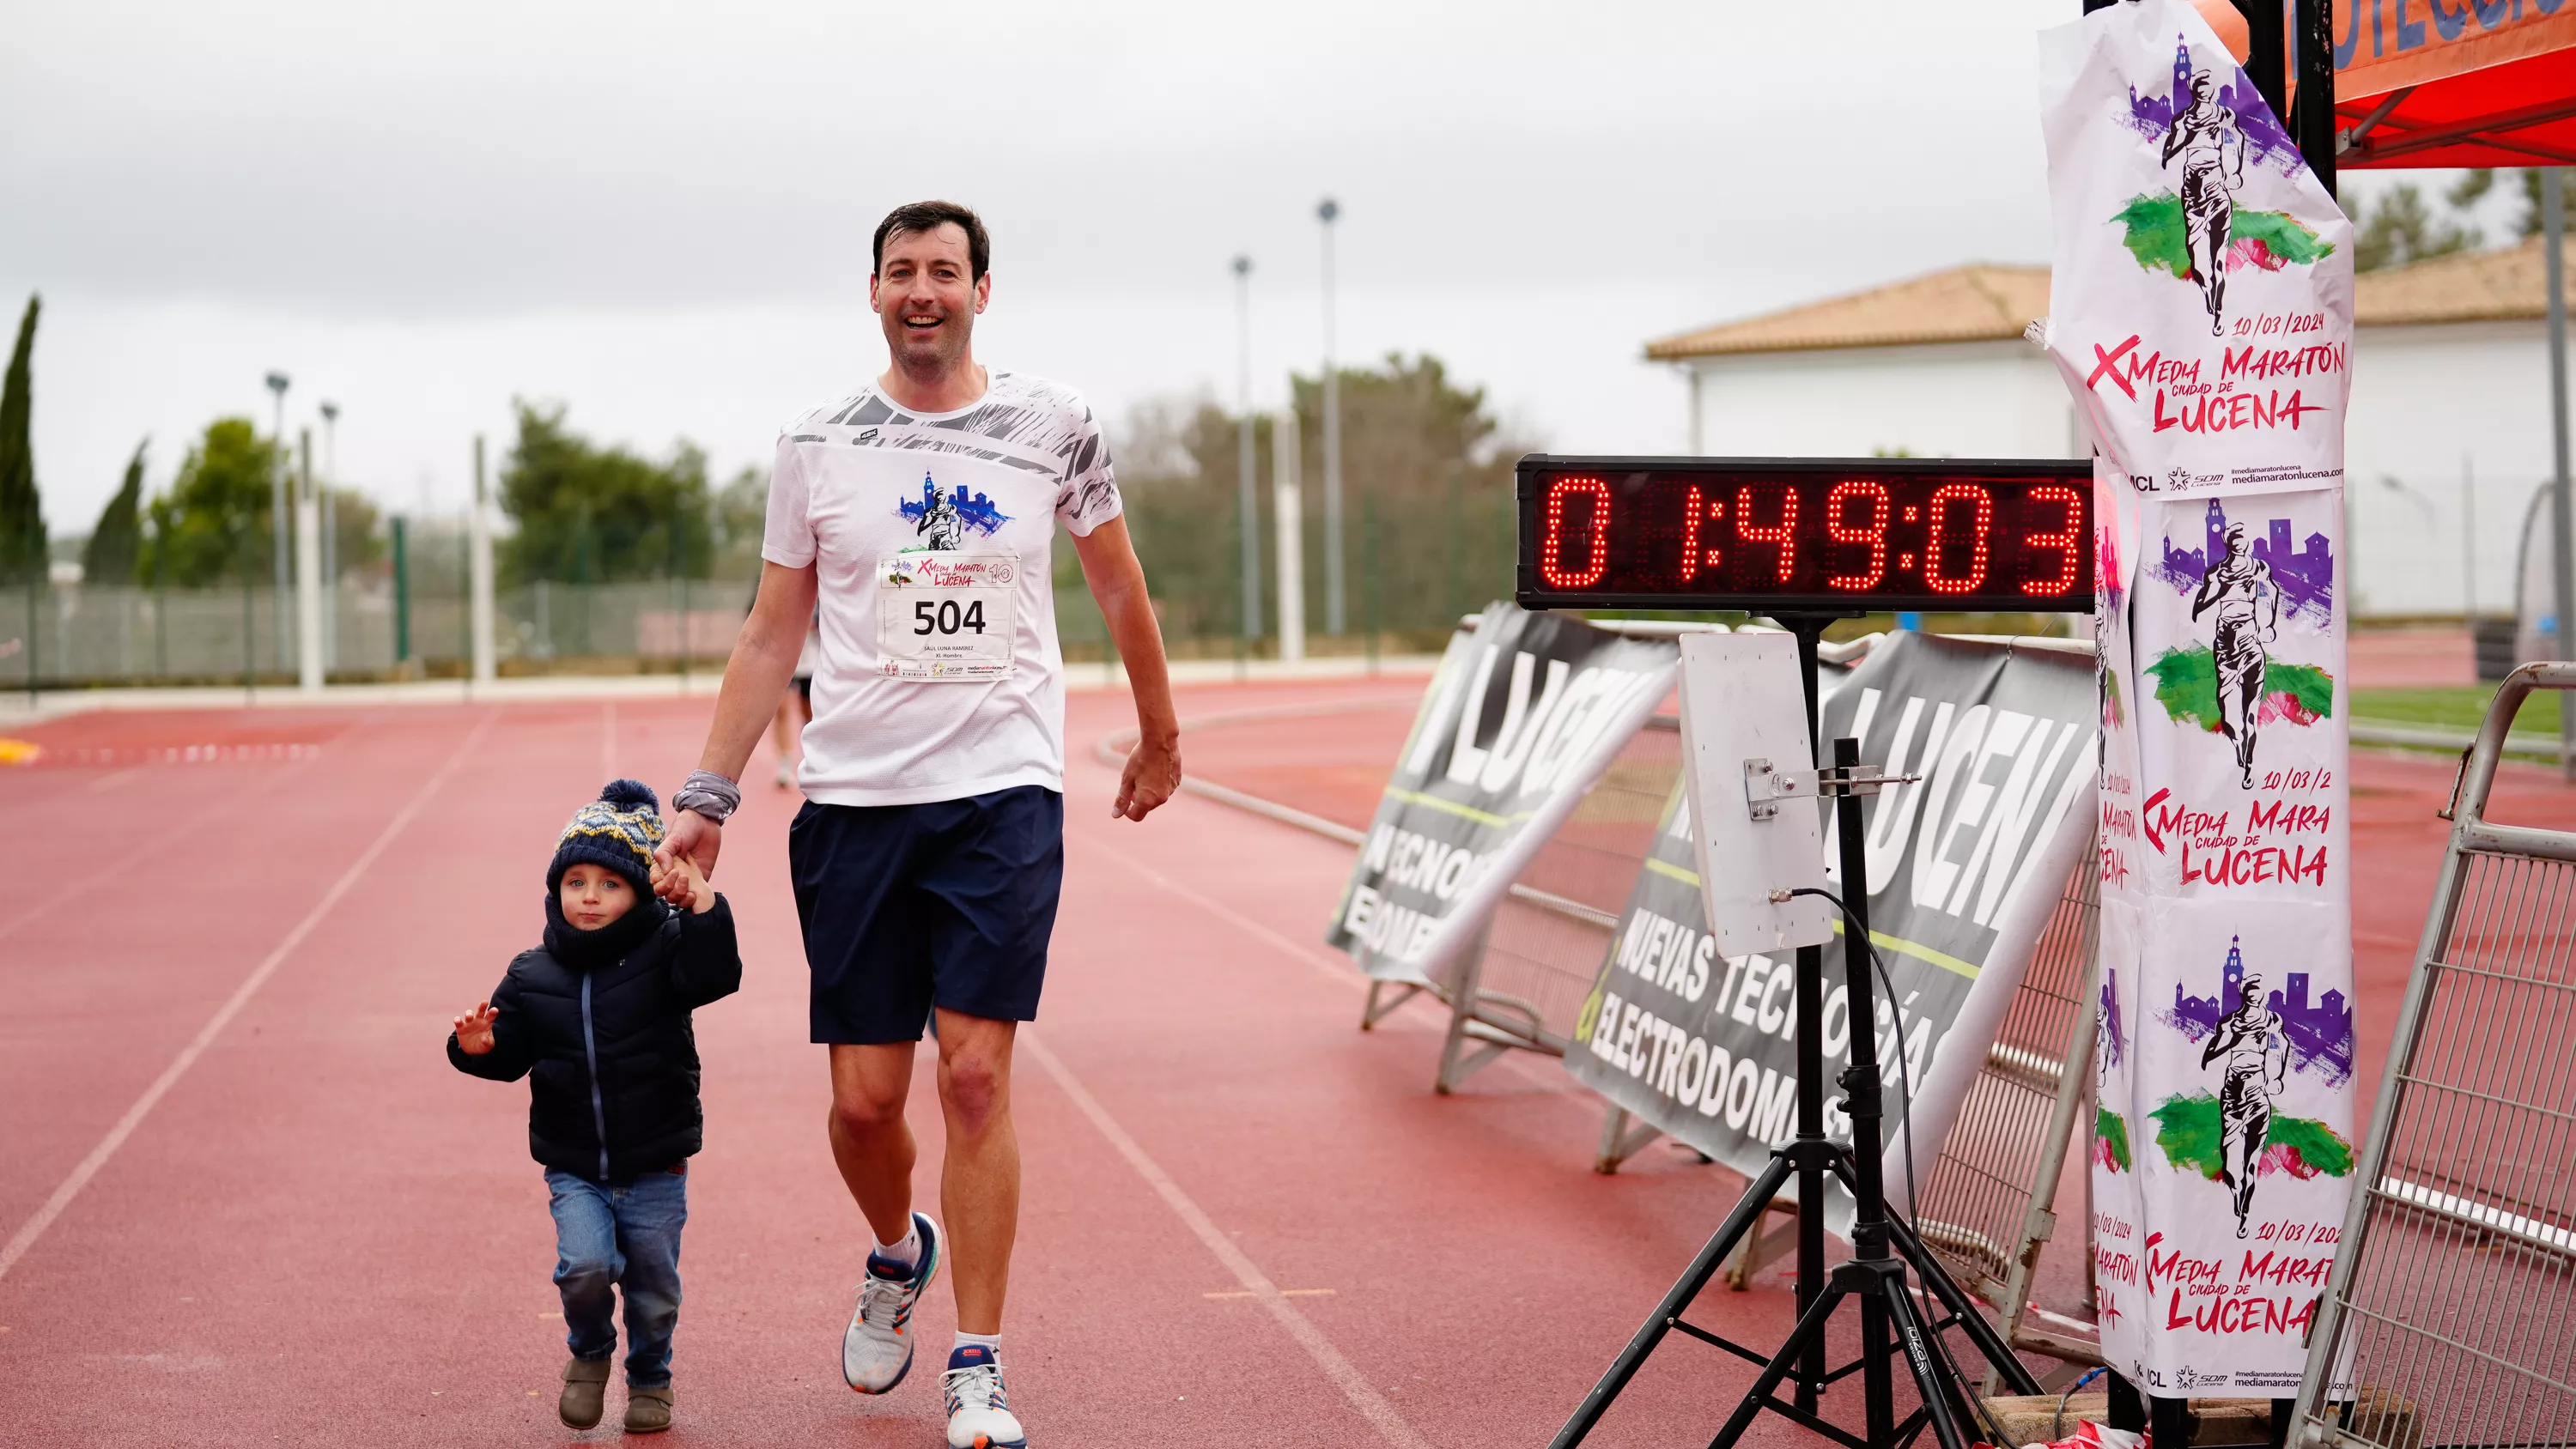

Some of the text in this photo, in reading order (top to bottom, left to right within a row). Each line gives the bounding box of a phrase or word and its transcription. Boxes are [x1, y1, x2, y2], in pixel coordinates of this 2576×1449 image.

[2231, 311, 2324, 341] 10/03/2024
[2172, 381, 2234, 397] CIUDAD DE
[2231, 464, 2301, 475] #mediamaratonlucena
[914, 599, 986, 636] 504
[2195, 835, 2260, 849] CIUDAD DE
[2180, 841, 2328, 888] LUCENA
[1616, 906, 1716, 1003] NUEVAS
[2189, 1284, 2251, 1296] CIUDAD DE
